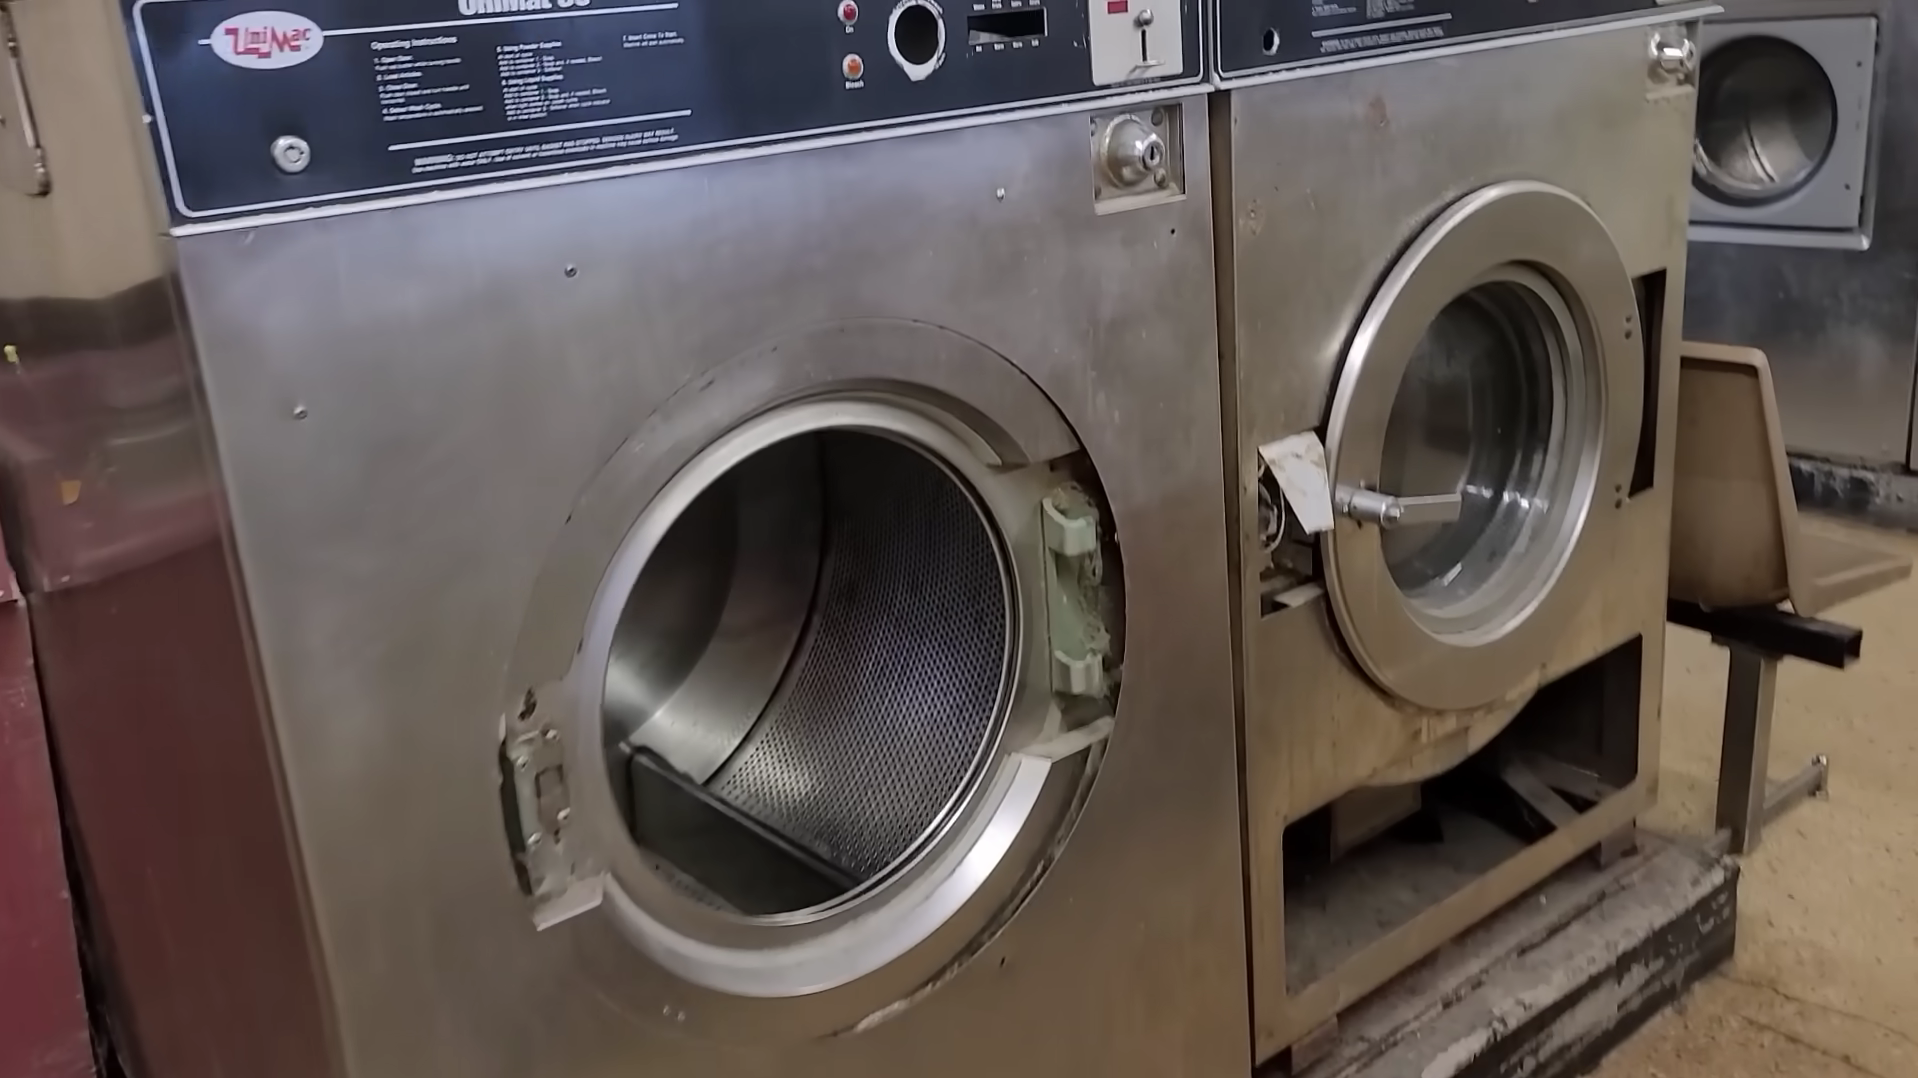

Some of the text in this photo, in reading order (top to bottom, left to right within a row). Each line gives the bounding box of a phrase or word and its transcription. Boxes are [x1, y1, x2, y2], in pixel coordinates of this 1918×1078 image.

[224, 26, 312, 58] UniMac
[370, 36, 457, 51] Operating Instructions
